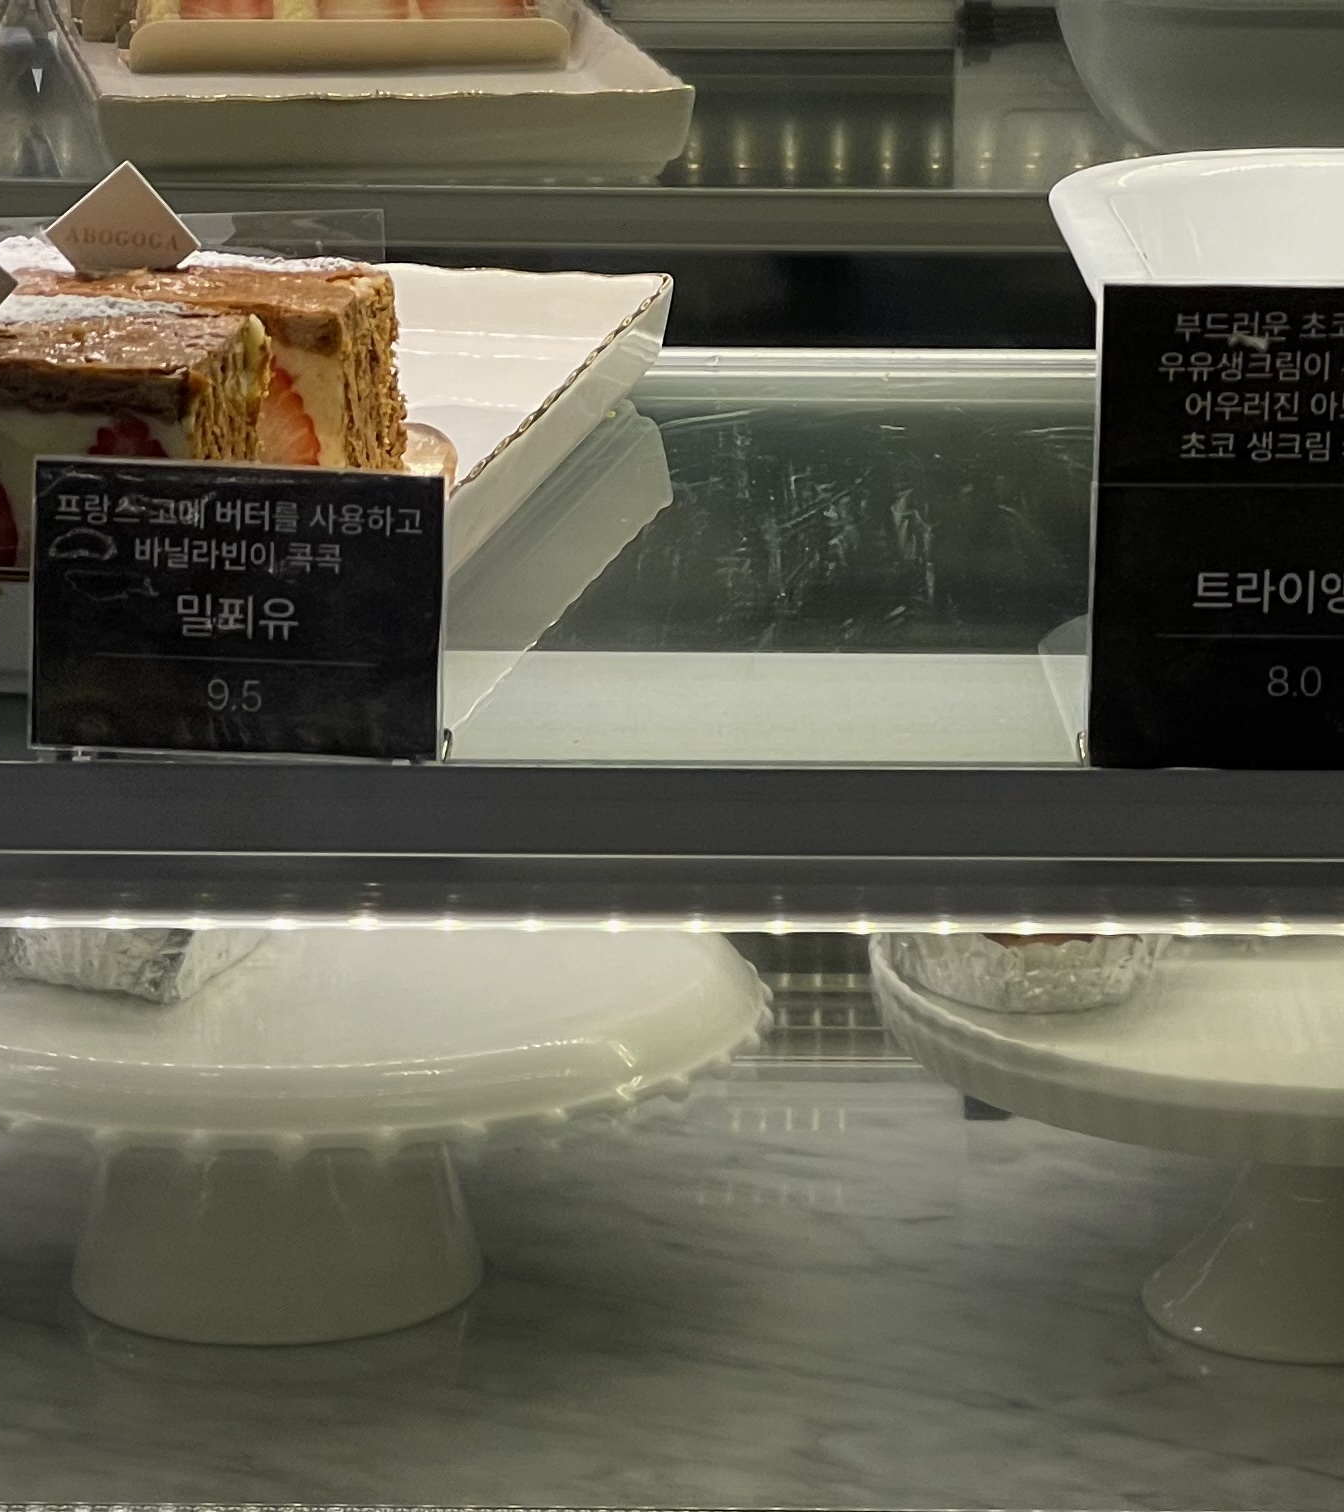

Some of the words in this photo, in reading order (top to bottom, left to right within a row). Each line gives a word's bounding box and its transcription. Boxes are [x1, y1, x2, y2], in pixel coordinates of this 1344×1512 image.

[65, 225, 179, 253] ABOGOGA
[1175, 312, 1292, 341] 부드러운
[1158, 350, 1332, 383] 우유생크림이
[1185, 391, 1301, 422] 어우러진
[1180, 432, 1236, 460] 초코
[1247, 431, 1331, 463] 생크림
[54, 493, 141, 526] 프랑스
[216, 501, 300, 533] 버터를
[309, 504, 424, 537] 사용하고
[134, 537, 276, 572] 바닐라빈이
[286, 542, 344, 575] 콕콕
[176, 592, 299, 641] 밀푀유
[206, 678, 262, 714] 9.5
[1267, 665, 1323, 698] 8.0
